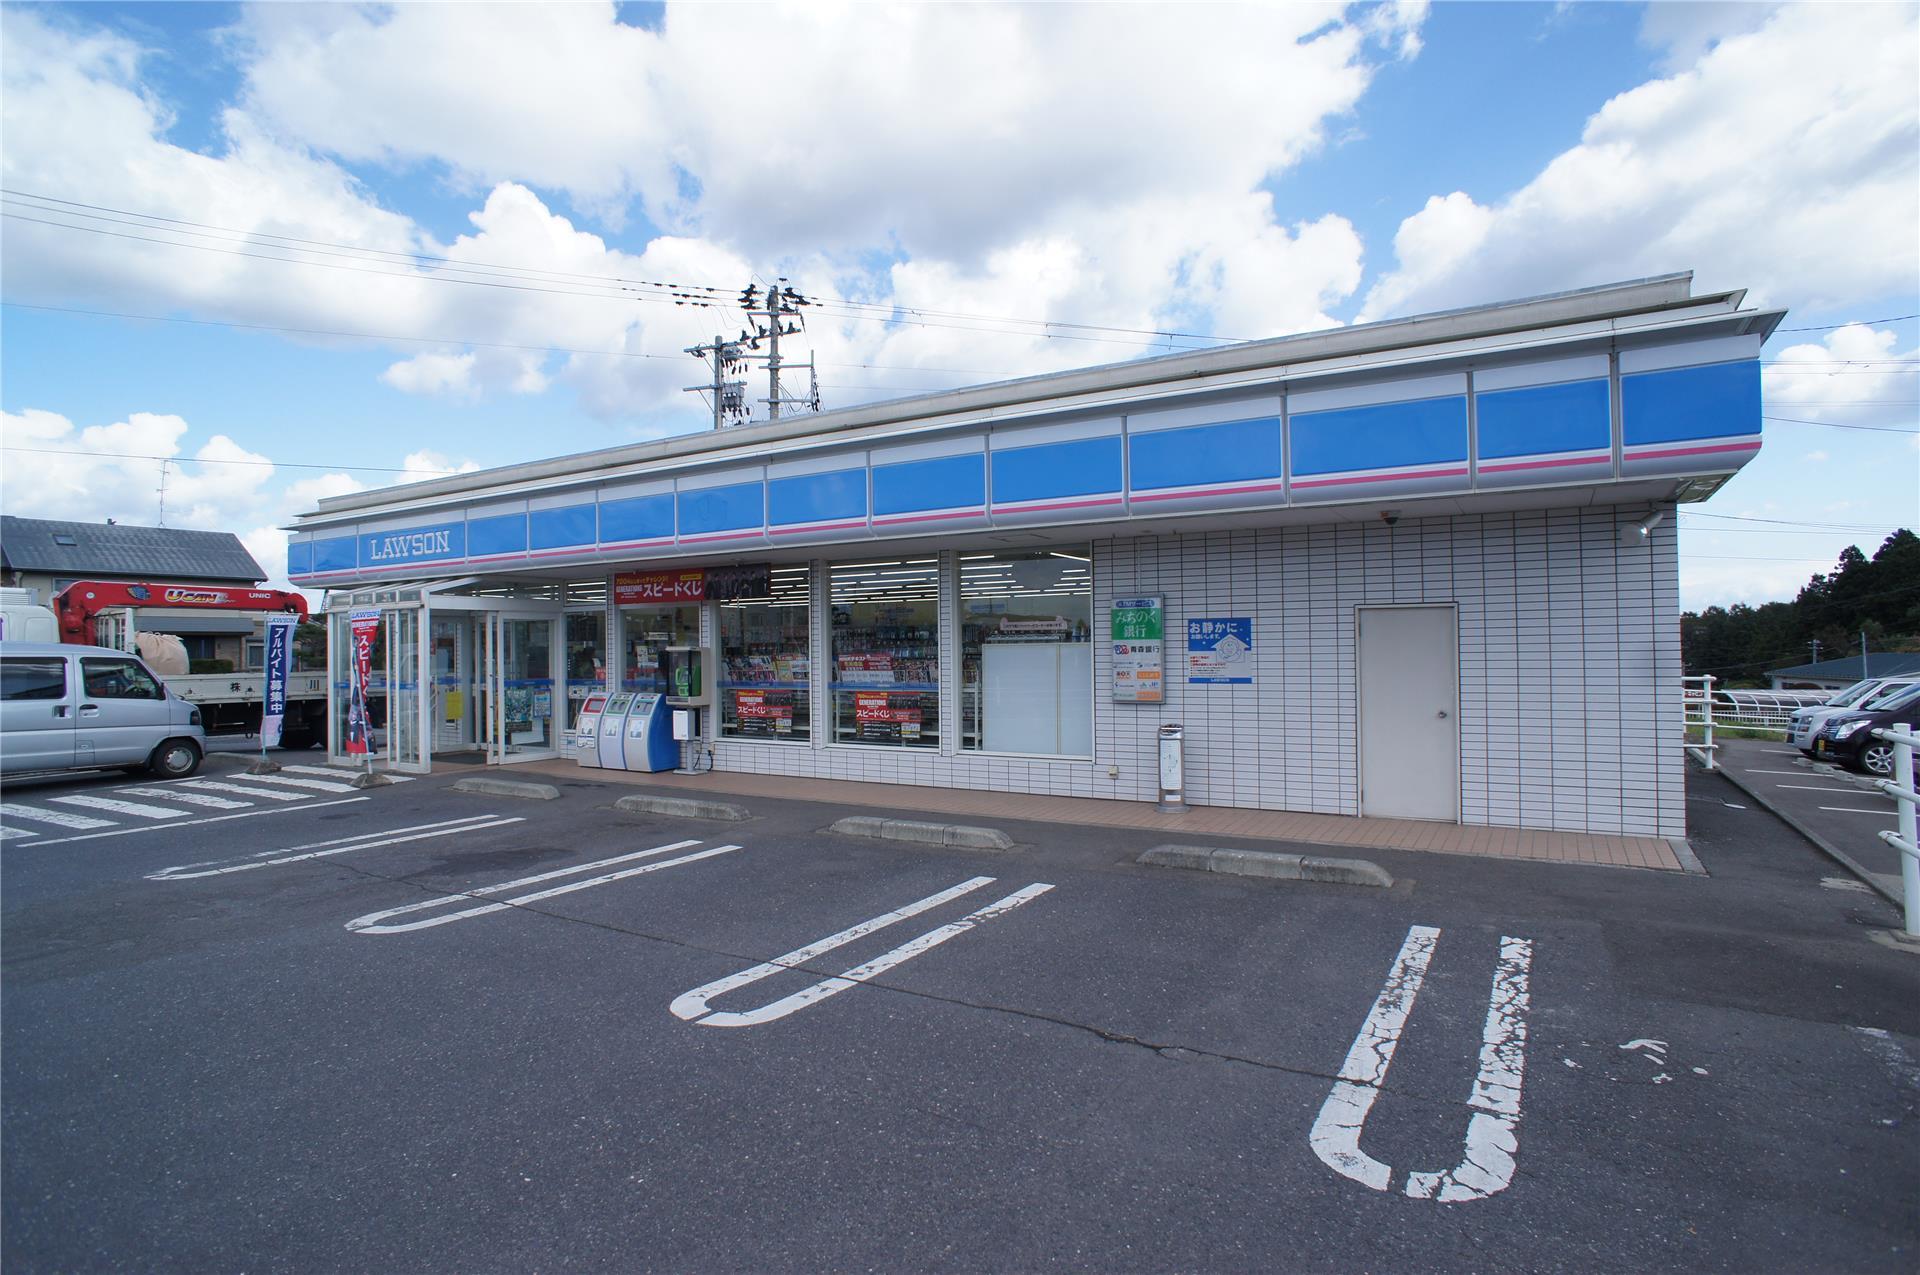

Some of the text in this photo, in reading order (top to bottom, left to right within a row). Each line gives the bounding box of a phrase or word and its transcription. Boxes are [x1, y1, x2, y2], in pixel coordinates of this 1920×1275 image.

[371, 531, 450, 560] LAWSON
[643, 581, 702, 597] スピードくじ
[1115, 611, 1156, 624] みちのく
[1124, 625, 1146, 638] 銀行
[1190, 622, 1238, 633] お静かに
[270, 628, 285, 713] アルバイト募集中
[230, 682, 241, 692] 株
[737, 706, 766, 714] スピードくじ
[856, 709, 890, 718] スピードくじ
